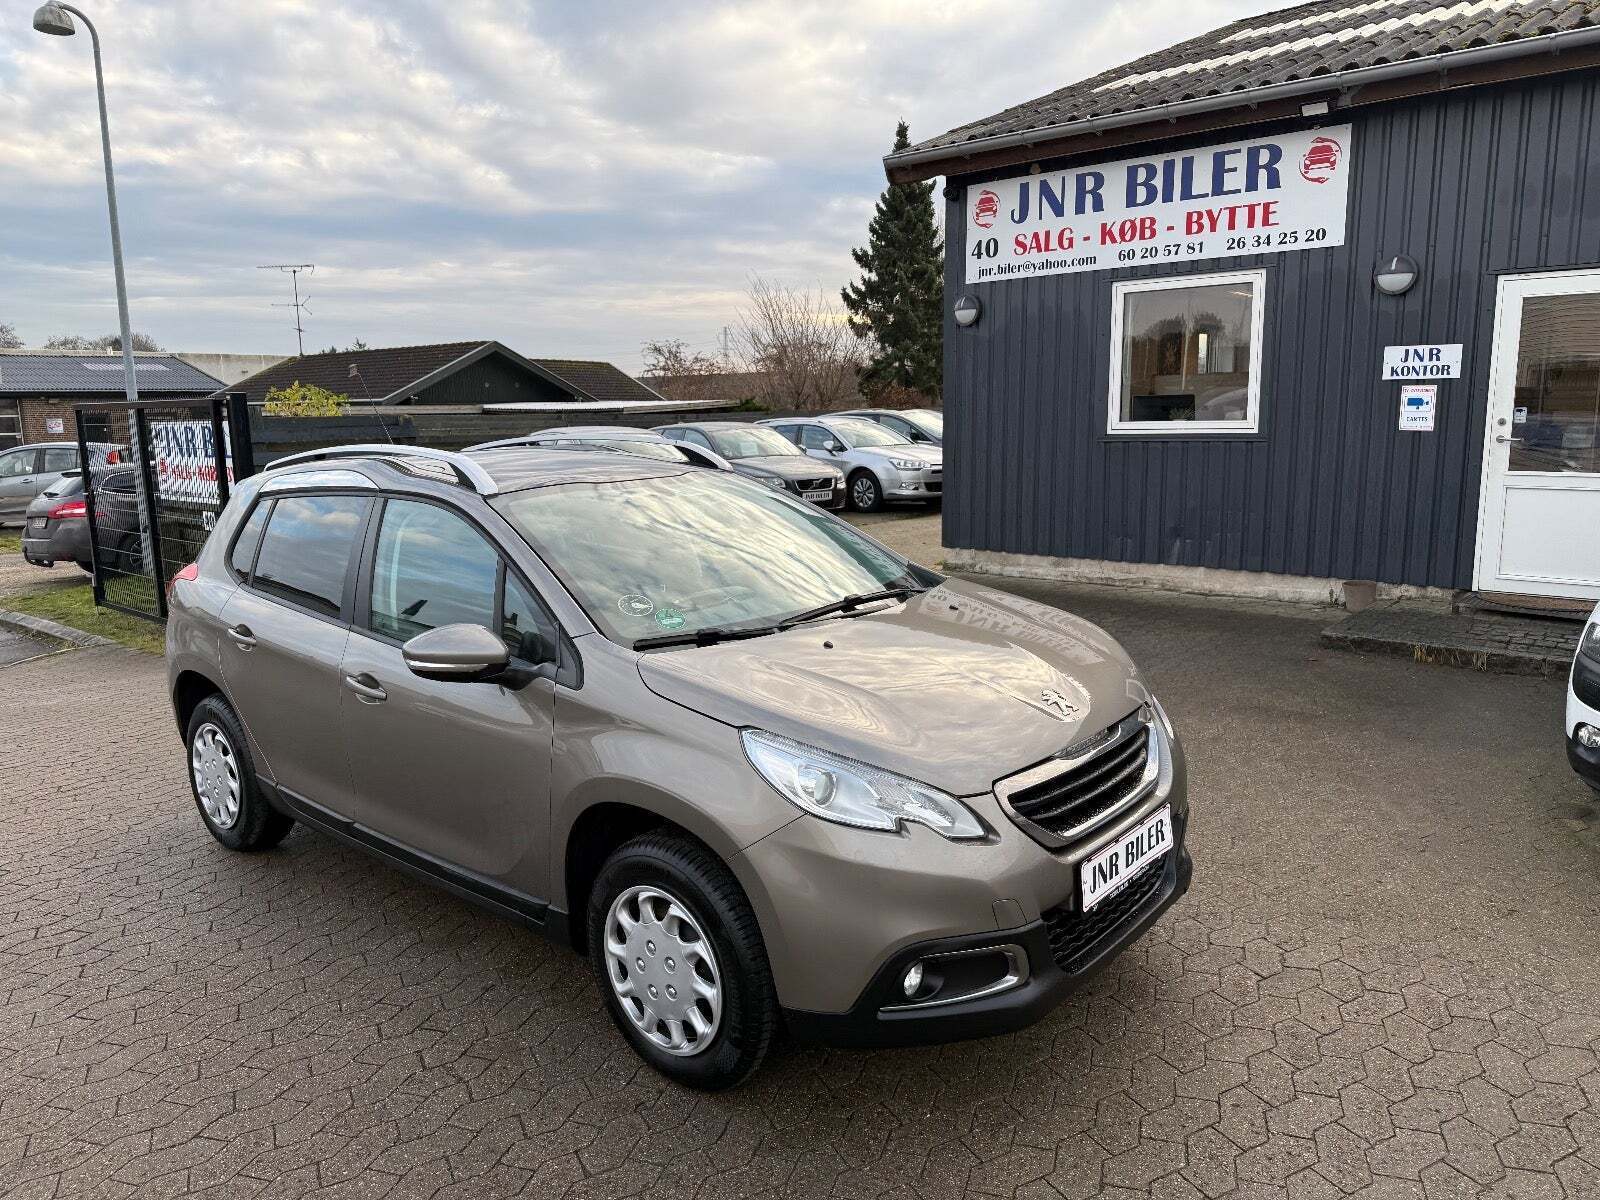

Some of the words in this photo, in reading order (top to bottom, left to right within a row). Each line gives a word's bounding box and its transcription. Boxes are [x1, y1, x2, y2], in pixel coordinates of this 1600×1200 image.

[1010, 171, 1104, 224] JNR
[1125, 143, 1283, 208] BILER
[1014, 227, 1074, 255] SALG
[1100, 216, 1157, 246] KØB
[1185, 200, 1280, 236] BYTTE
[971, 237, 999, 260] 40
[1118, 248, 1136, 262] 60
[1140, 246, 1158, 259] 20
[1163, 243, 1182, 257] 57
[1186, 241, 1204, 254] 81
[1226, 237, 1246, 251] 26
[1251, 234, 1272, 248] 34
[1278, 230, 1299, 244] 25
[1304, 227, 1327, 242] 20
[978, 255, 1097, 280] jnr.biler@yahoo.com
[1400, 347, 1441, 363] JNR
[1390, 364, 1451, 377] KONTOR
[1089, 851, 1120, 894] JNR
[1125, 818, 1166, 869] BILER
